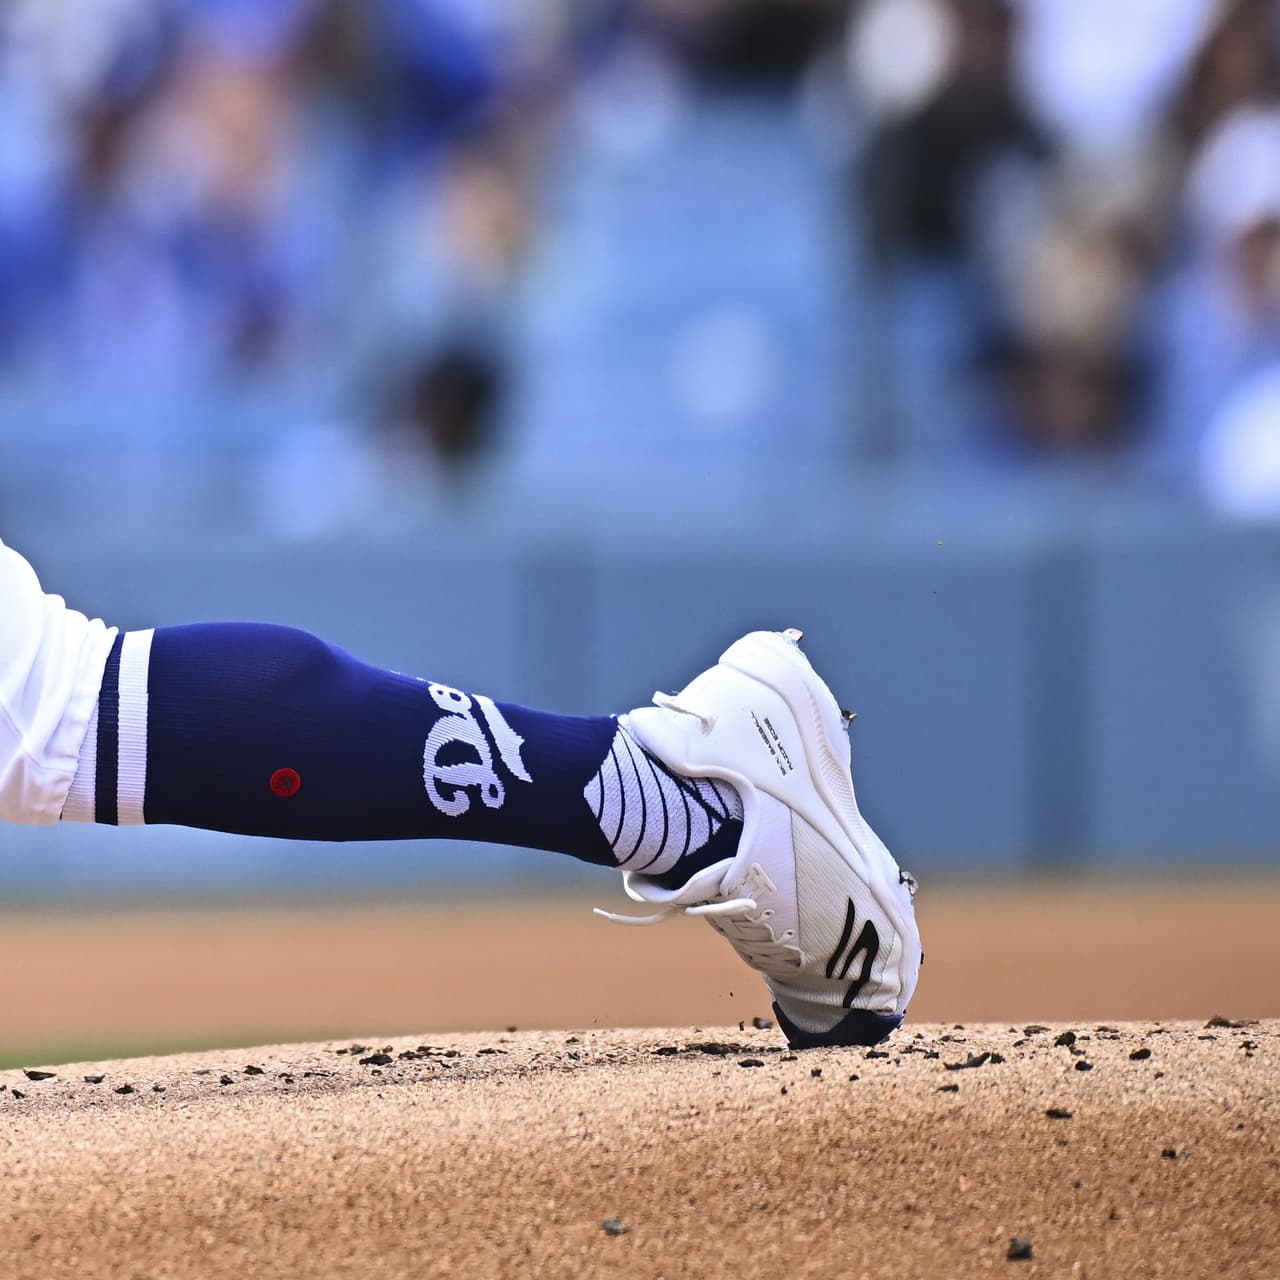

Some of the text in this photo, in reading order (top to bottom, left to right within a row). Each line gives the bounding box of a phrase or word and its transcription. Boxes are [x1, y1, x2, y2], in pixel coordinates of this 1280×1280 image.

[422, 682, 506, 817] Do
[750, 711, 776, 756] BASEBALL
[777, 742, 794, 771] RAZOR
